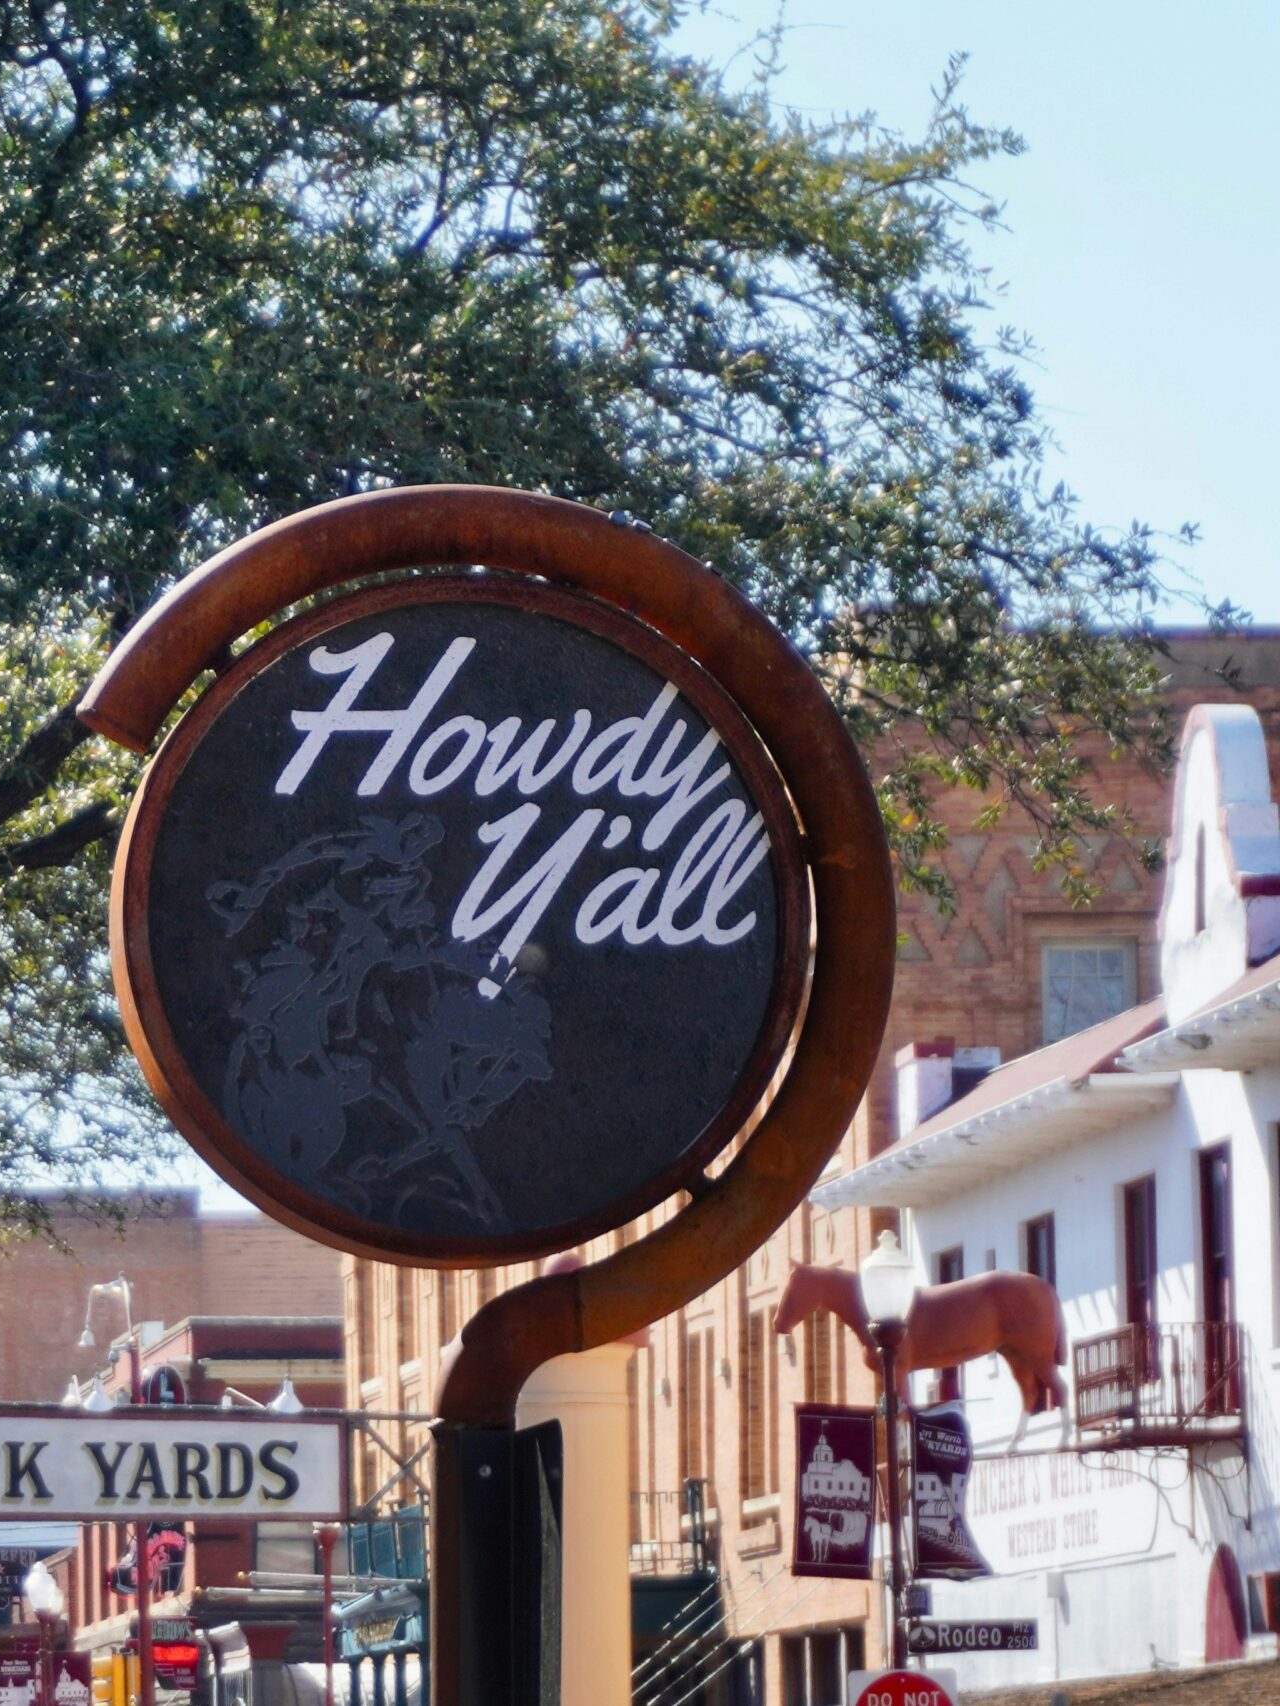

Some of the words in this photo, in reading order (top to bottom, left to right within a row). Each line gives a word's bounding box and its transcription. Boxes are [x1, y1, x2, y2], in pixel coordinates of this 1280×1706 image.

[276, 632, 732, 850] Howdy
[452, 798, 770, 1000] Y'all
[83, 1439, 301, 1501] YARDS
[971, 1456, 1042, 1517] INCHER'S
[1008, 1516, 1057, 1560] WESTERN
[1063, 1508, 1100, 1550] STORE
[937, 1623, 1002, 1647] Rodeo
[1007, 1636, 1036, 1649] 2500
[867, 1692, 893, 1706] DO
[904, 1691, 941, 1706] NOT
